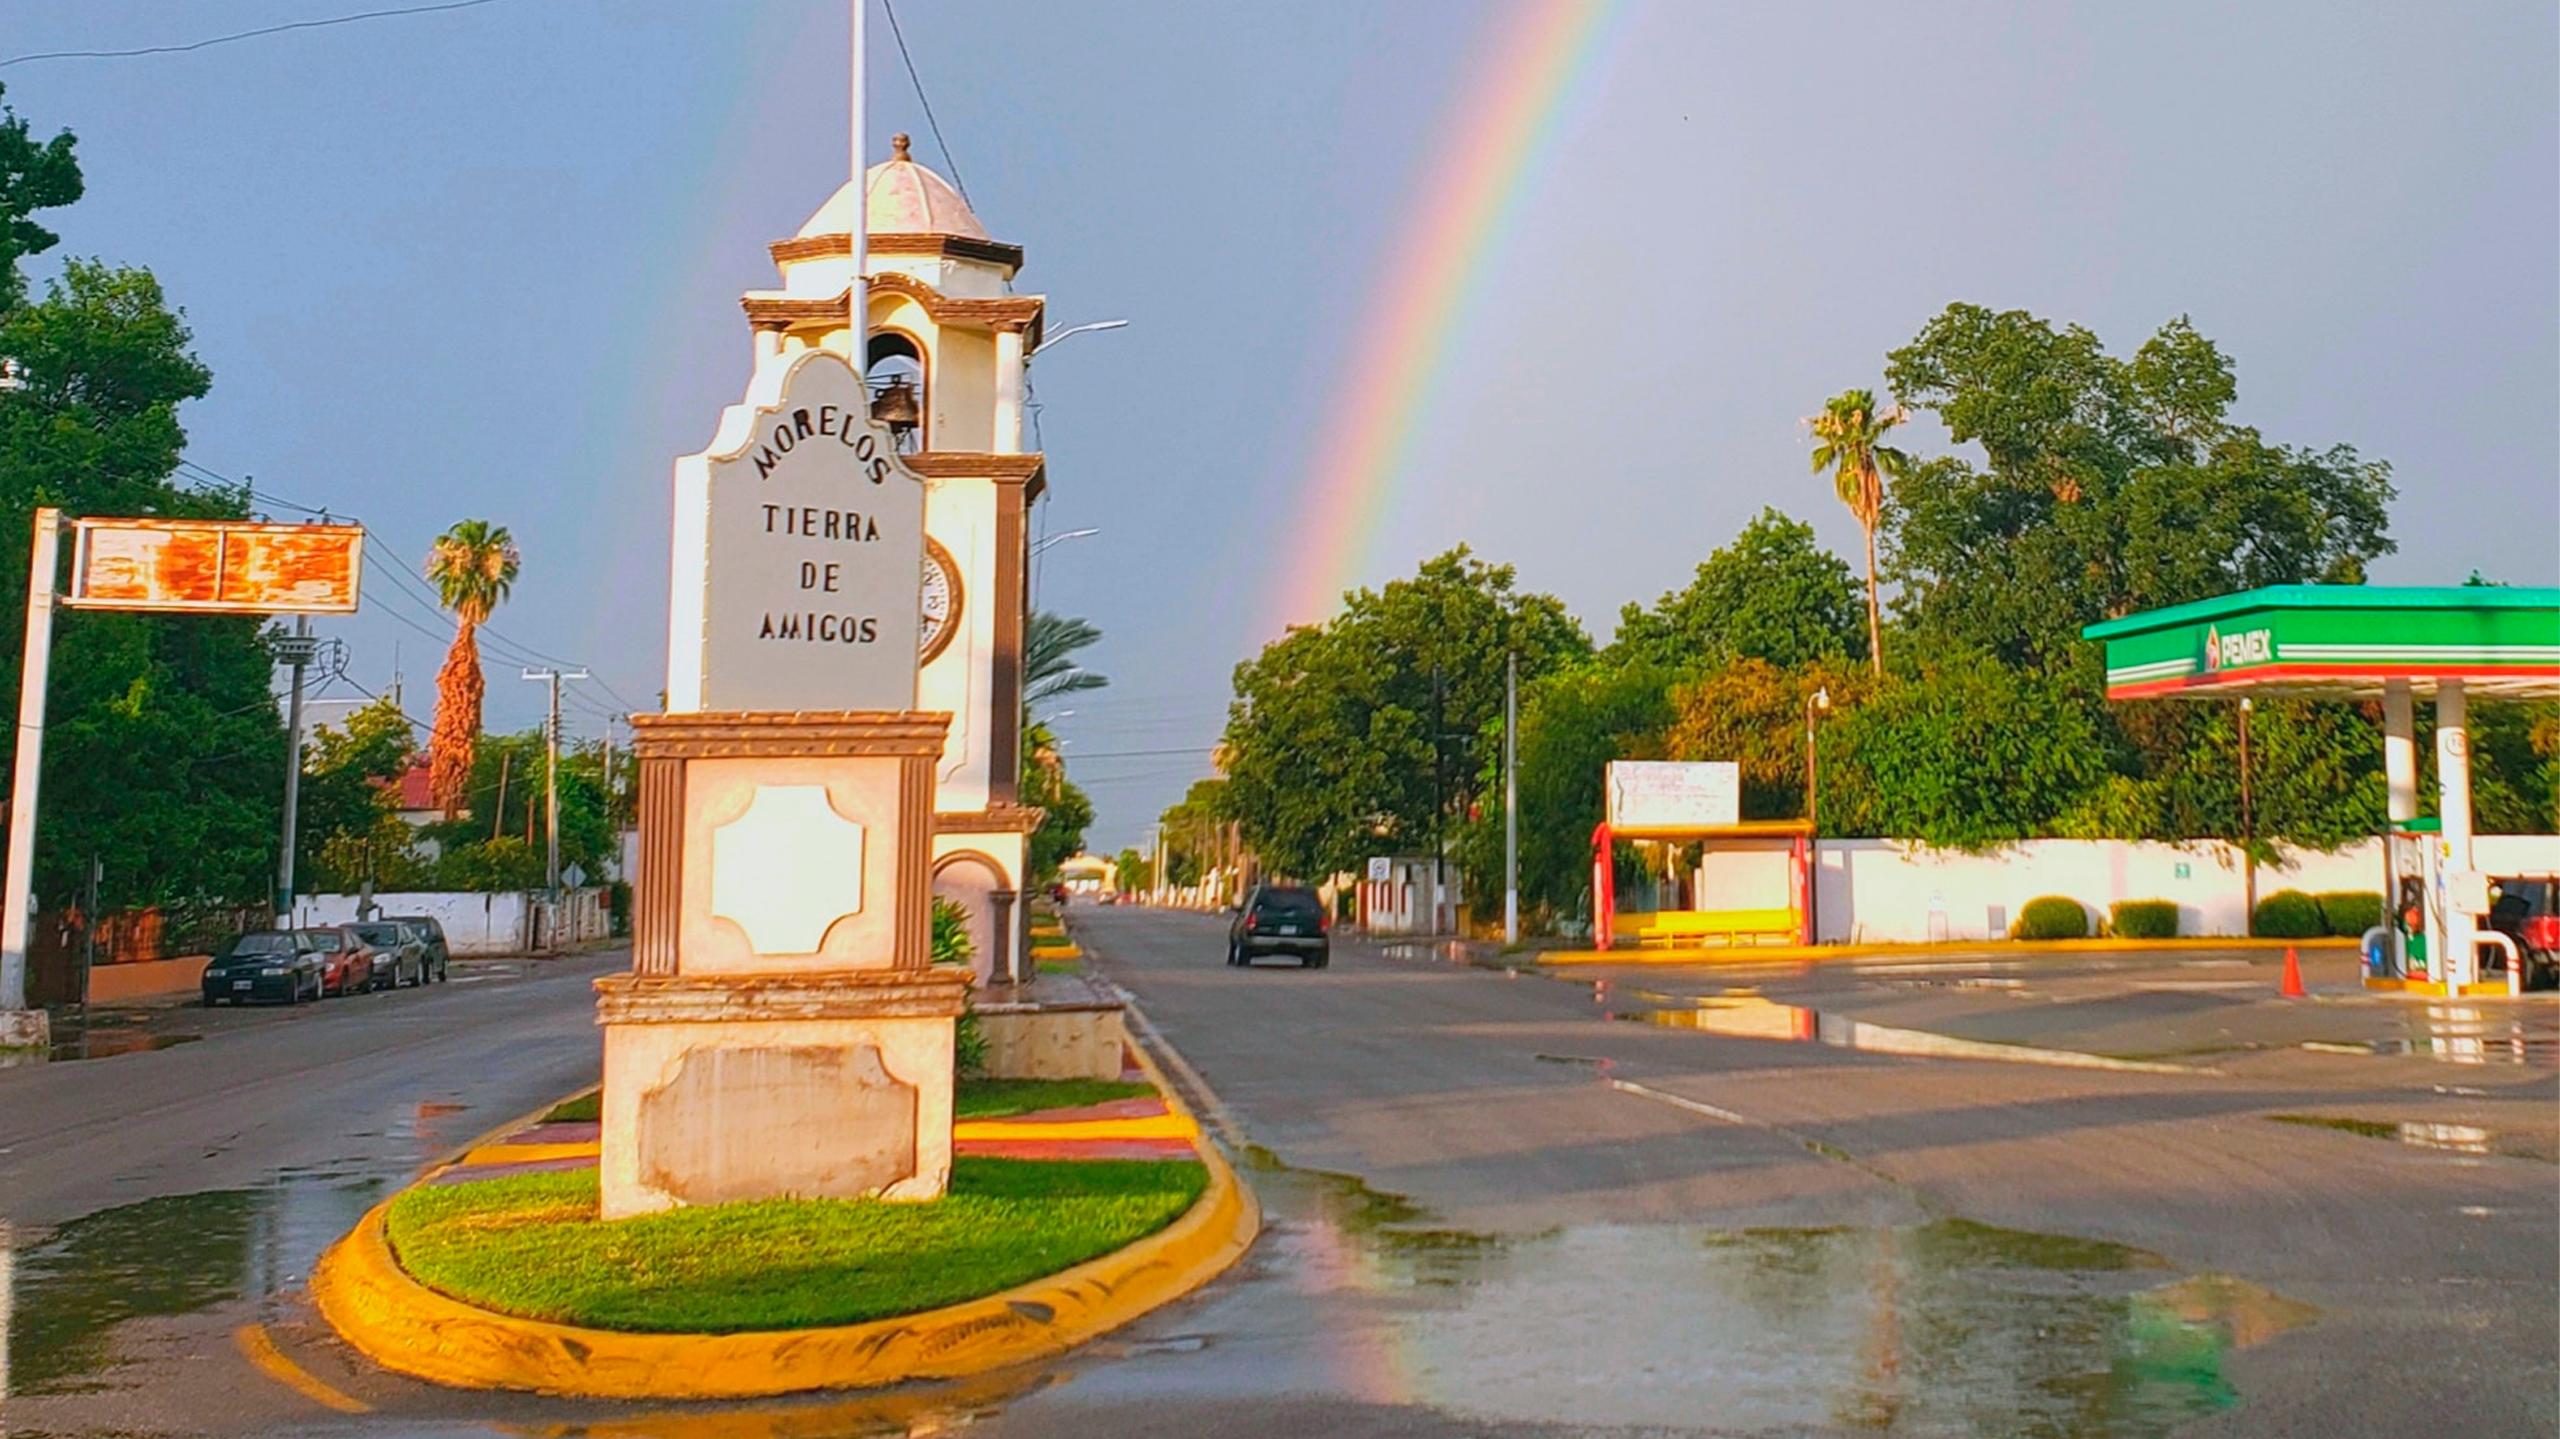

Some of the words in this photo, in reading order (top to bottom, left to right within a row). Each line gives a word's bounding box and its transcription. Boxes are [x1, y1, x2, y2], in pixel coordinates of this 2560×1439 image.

[753, 405, 892, 485] MORELOS
[762, 504, 880, 542] TIERRA
[801, 561, 841, 592] DE
[927, 595, 939, 610] 3
[759, 611, 877, 643] AMIGOS
[2221, 628, 2273, 666] PEMEX
